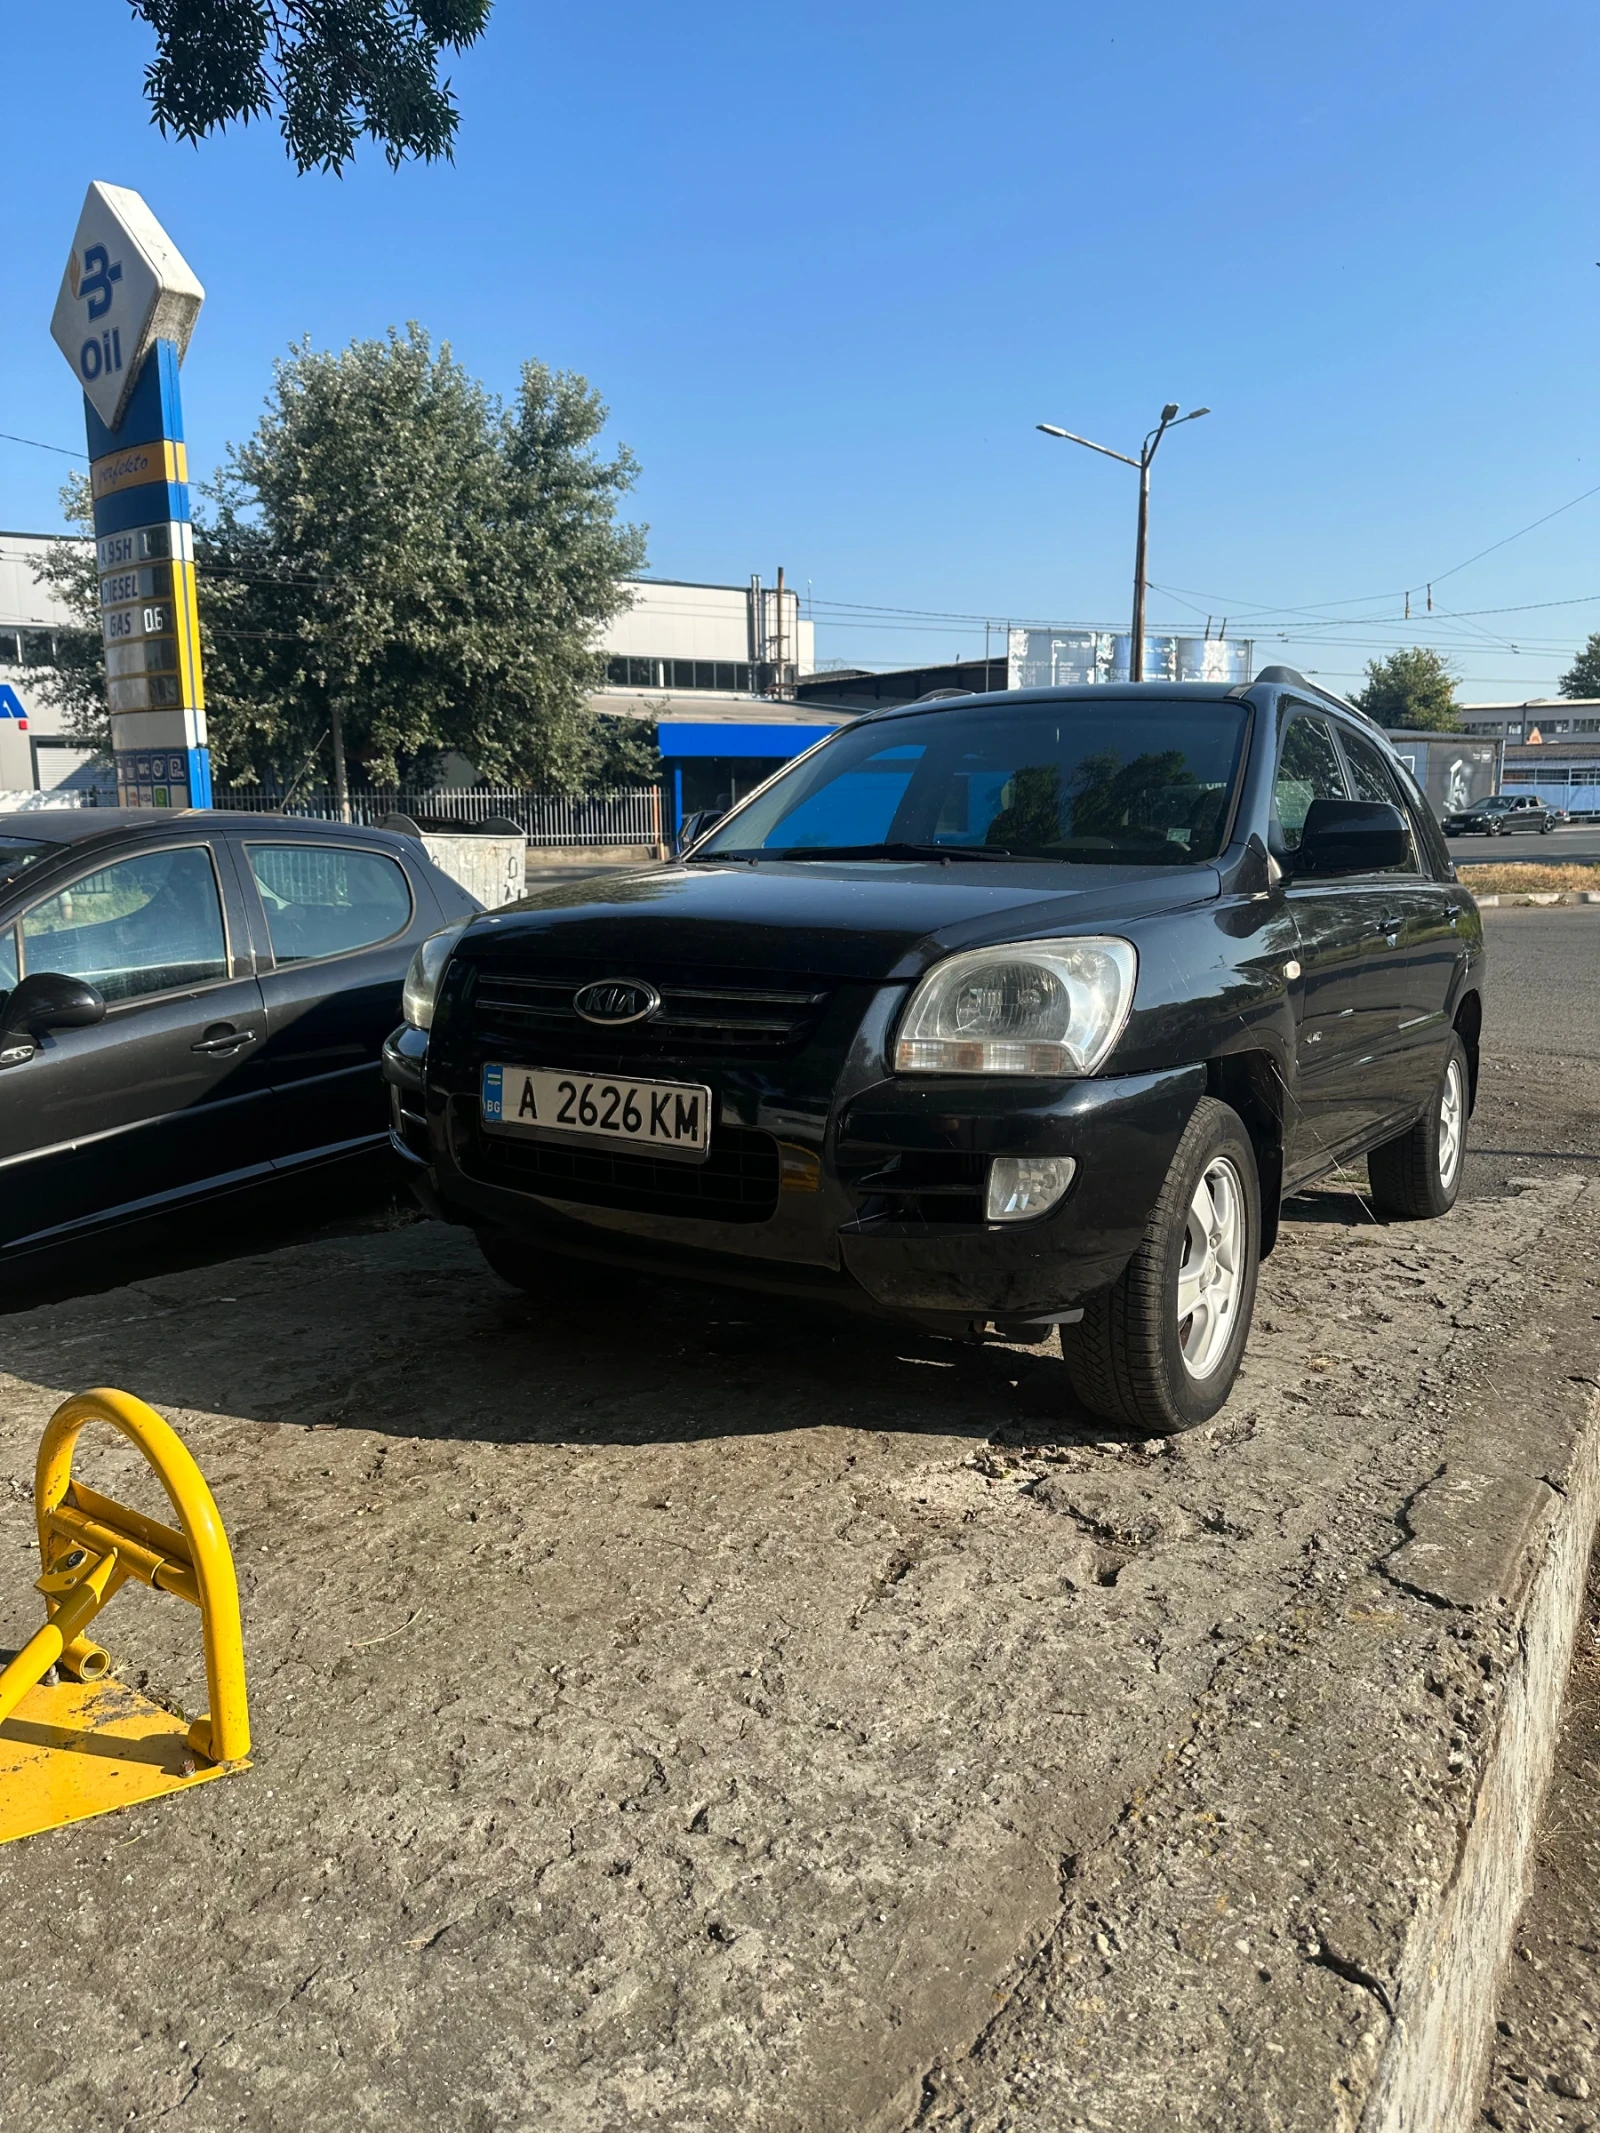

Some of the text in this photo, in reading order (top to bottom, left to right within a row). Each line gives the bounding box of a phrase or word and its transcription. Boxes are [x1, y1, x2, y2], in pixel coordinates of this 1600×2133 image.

[103, 575, 138, 604] DIESEL
[110, 612, 131, 637] GAS
[138, 763, 150, 774] WC
[584, 987, 635, 1014] KIA
[486, 1100, 501, 1114] BG
[518, 1076, 699, 1142] A 2626 KM
